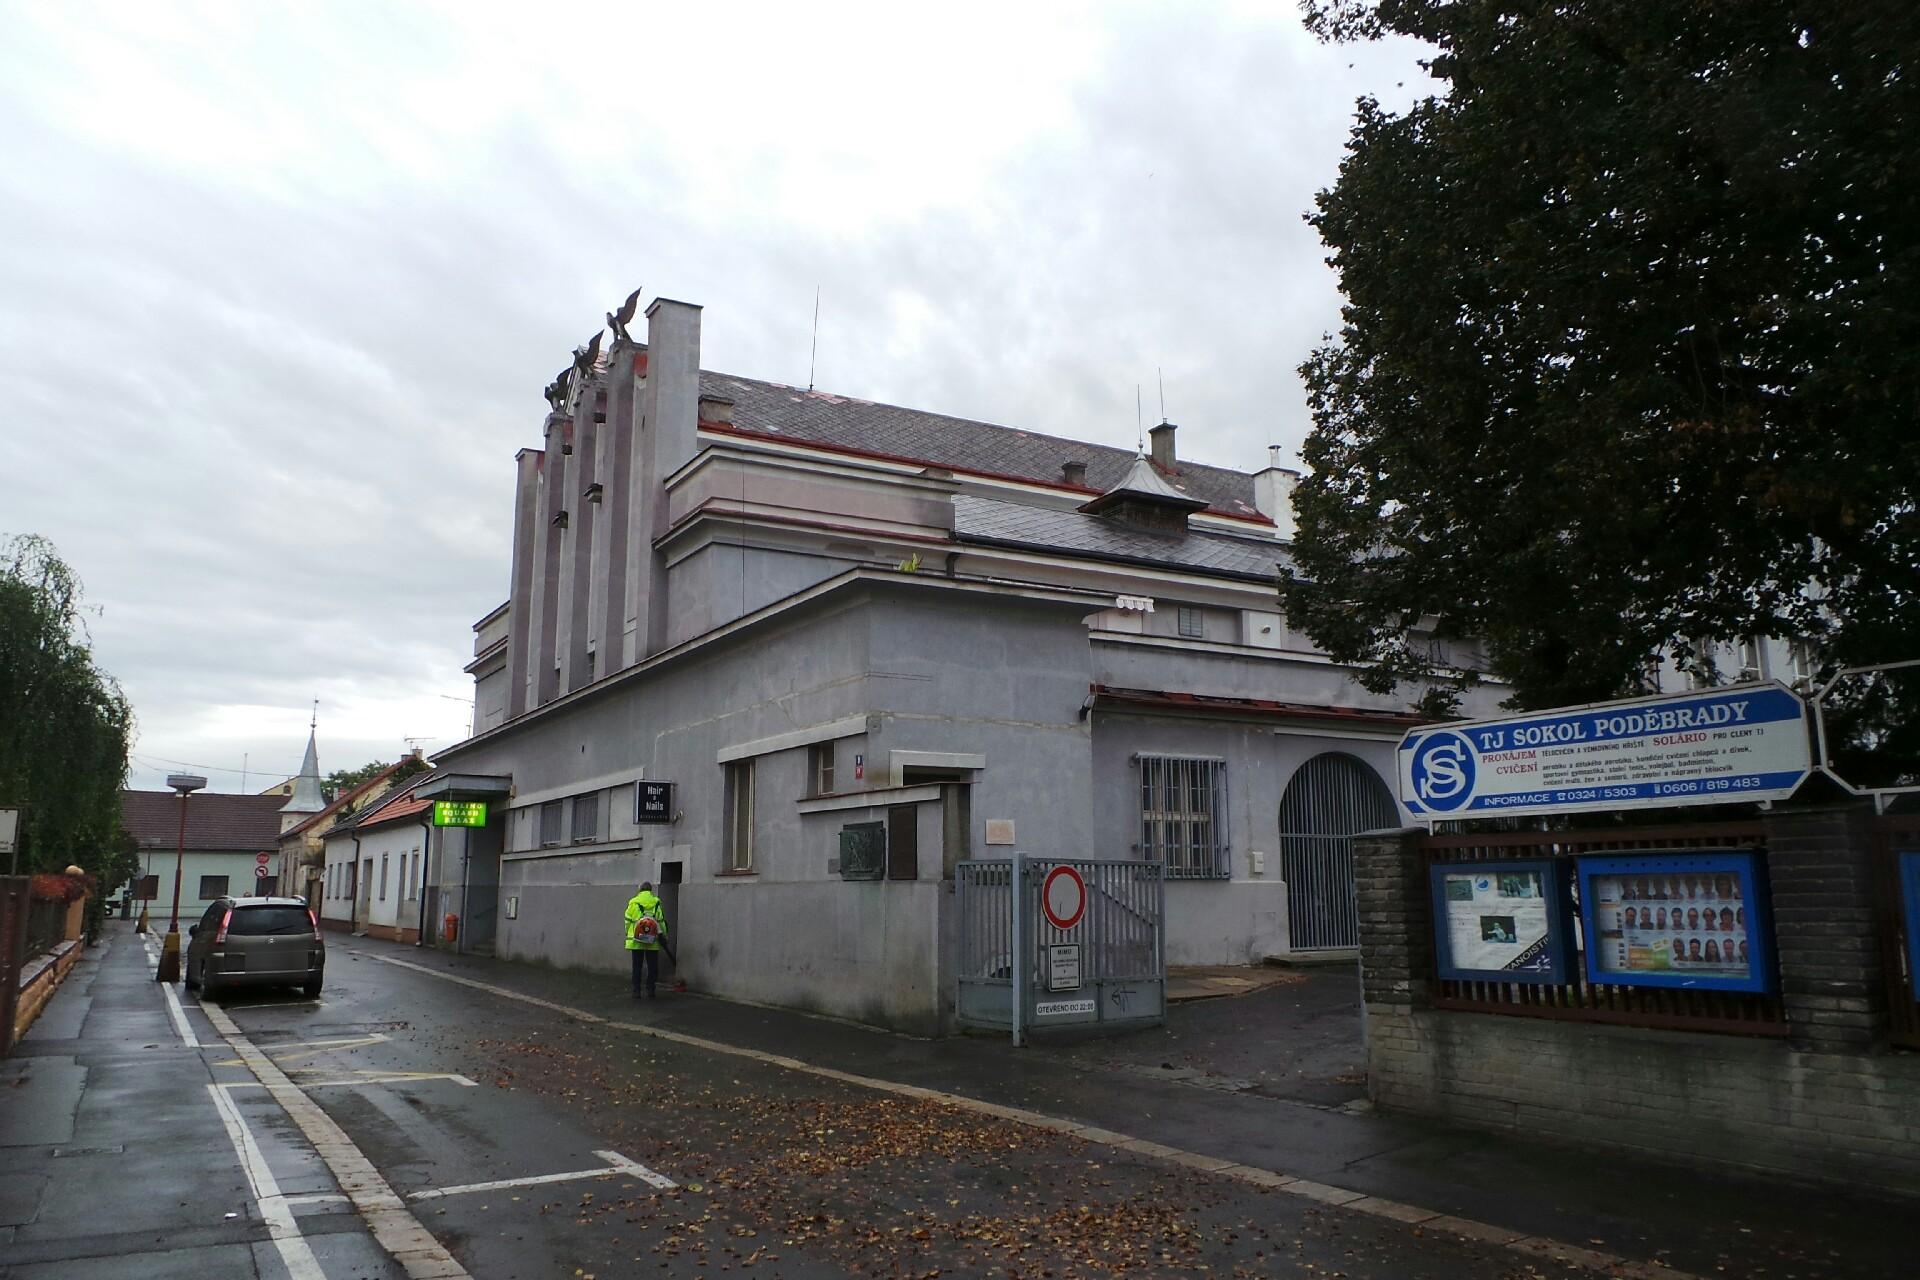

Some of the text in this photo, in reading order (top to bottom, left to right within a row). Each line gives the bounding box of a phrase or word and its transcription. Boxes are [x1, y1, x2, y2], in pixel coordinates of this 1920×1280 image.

[1480, 701, 1749, 750] TJ SOKOL PODĚBRADY
[1483, 750, 1537, 763] PRONÁJEM
[1653, 731, 1707, 746] SOLÁRIO
[1713, 732, 1727, 740] PRO
[1496, 762, 1538, 775] CVIČENÍ
[647, 785, 663, 795] Hair
[1485, 793, 1551, 806] INFORMACE
[1567, 790, 1596, 800] 0324
[1604, 787, 1637, 798] 5303
[1663, 782, 1697, 793] 0606
[1706, 779, 1729, 790] 819
[1732, 777, 1760, 788] 483
[645, 801, 664, 811] Nails
